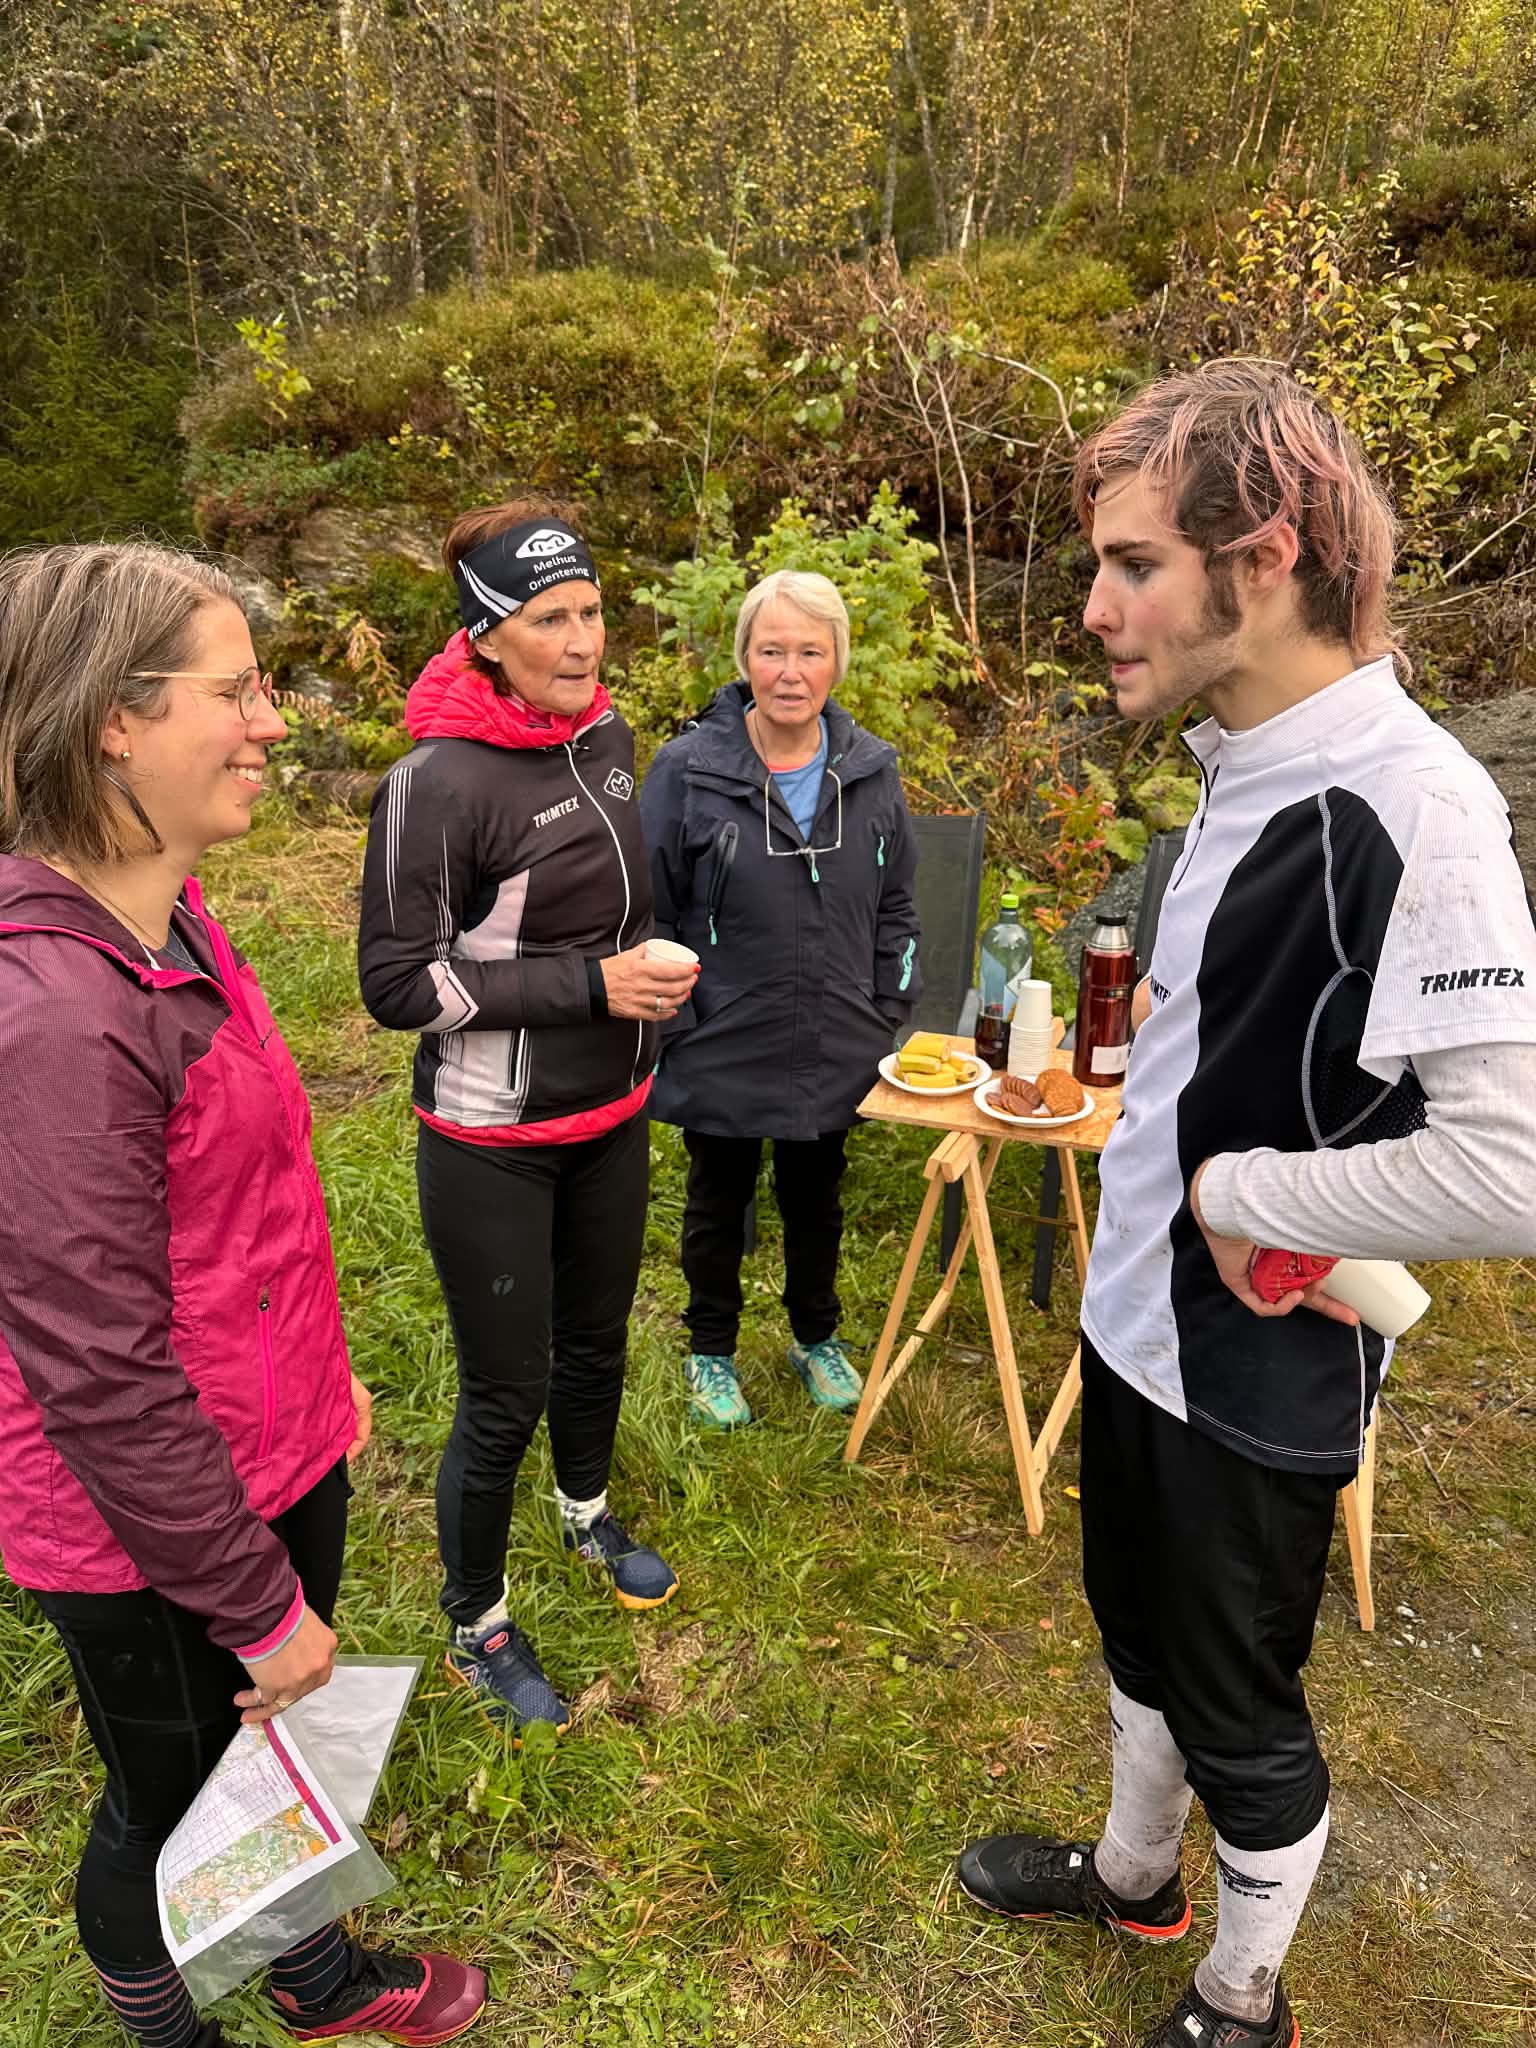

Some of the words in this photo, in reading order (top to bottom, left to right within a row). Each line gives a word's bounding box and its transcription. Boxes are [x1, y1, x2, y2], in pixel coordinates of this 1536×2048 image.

[533, 555, 577, 574] Melhus
[528, 566, 590, 591] Orientering
[533, 797, 580, 828] TRIMTEX
[1420, 968, 1525, 995] TRIMTEX
